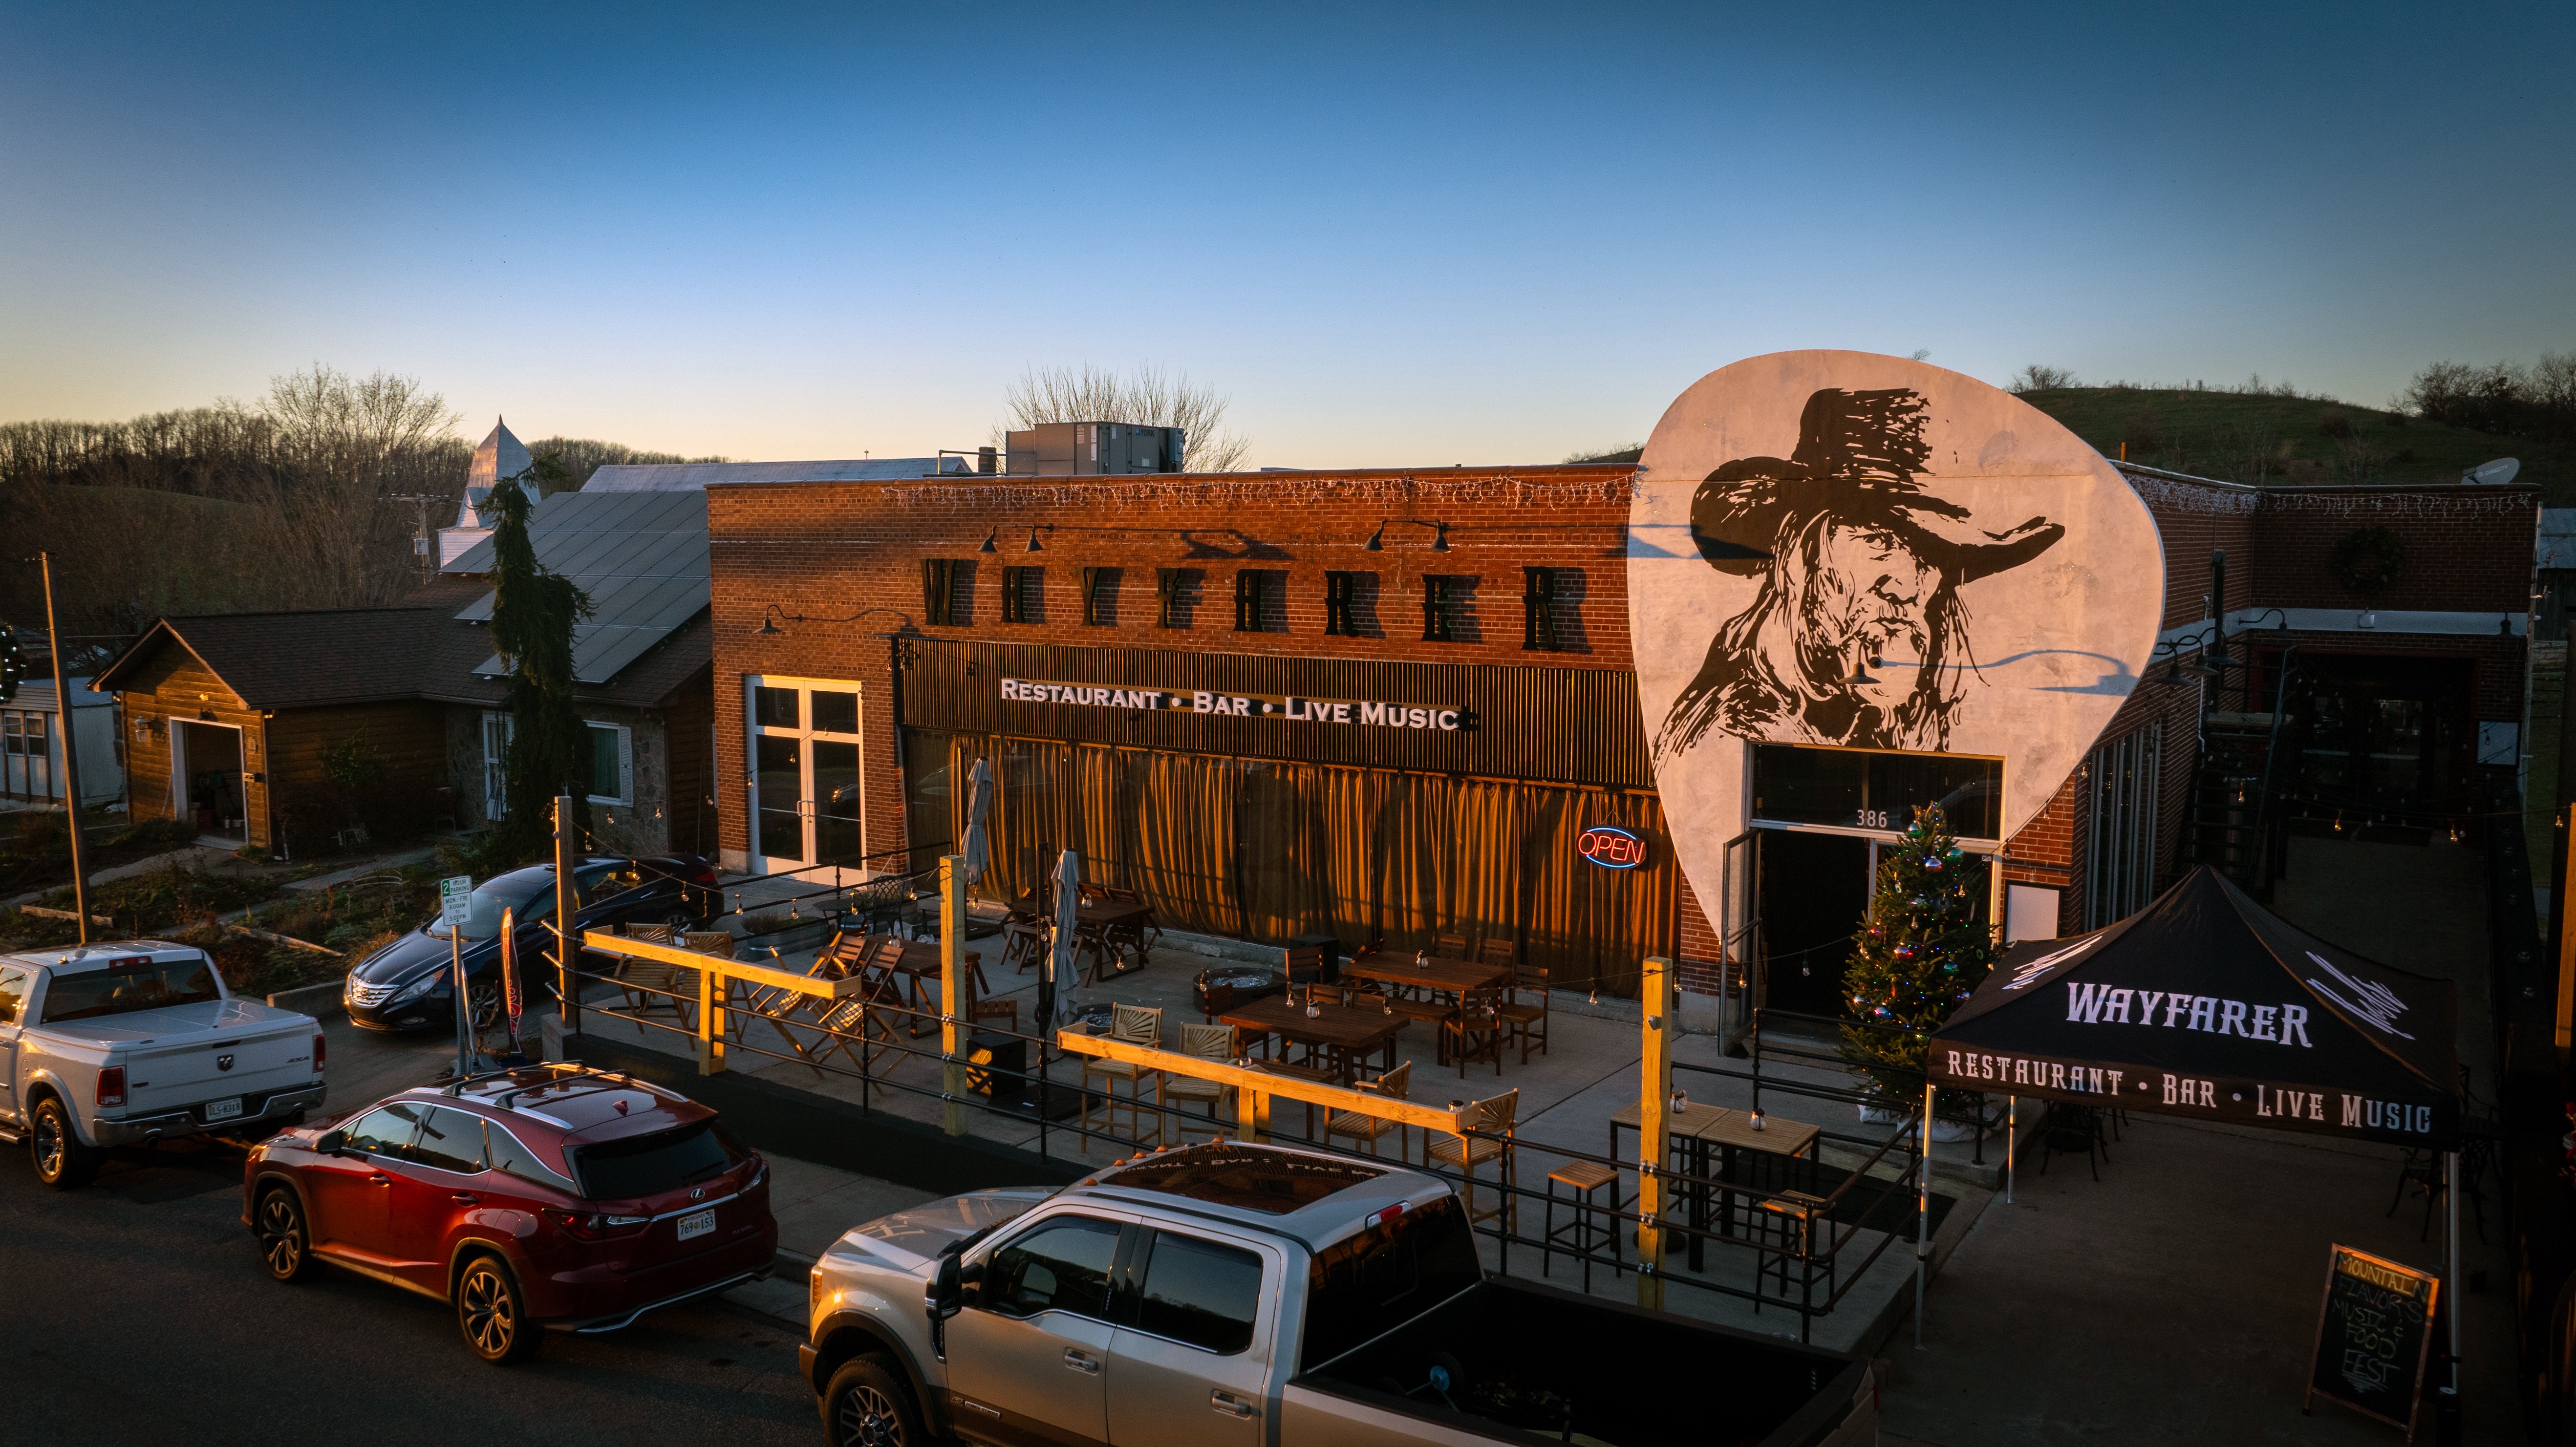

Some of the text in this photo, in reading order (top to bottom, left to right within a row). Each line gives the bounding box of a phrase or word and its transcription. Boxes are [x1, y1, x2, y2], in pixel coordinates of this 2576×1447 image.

[1141, 428, 1155, 437] YORK
[919, 558, 1562, 652] WAYFARER
[1000, 678, 1460, 731] RESTAURANT BAR LIVE MUSIC
[1856, 809, 1888, 828] 386
[1578, 832, 1646, 864] OPEN
[443, 883, 449, 894] 2
[2066, 982, 2313, 1048] WAYFARER
[1947, 1050, 2432, 1133] RESTAURANT BAR LIVE MUSIC
[680, 1216, 714, 1235] 769 153
[2338, 1254, 2429, 1303] MOUNTAIN
[2332, 1299, 2387, 1333] MUSIC
[2339, 1275, 2423, 1324] FLAVORS
[2346, 1322, 2397, 1360] FOOD
[2342, 1348, 2405, 1383] FEST
